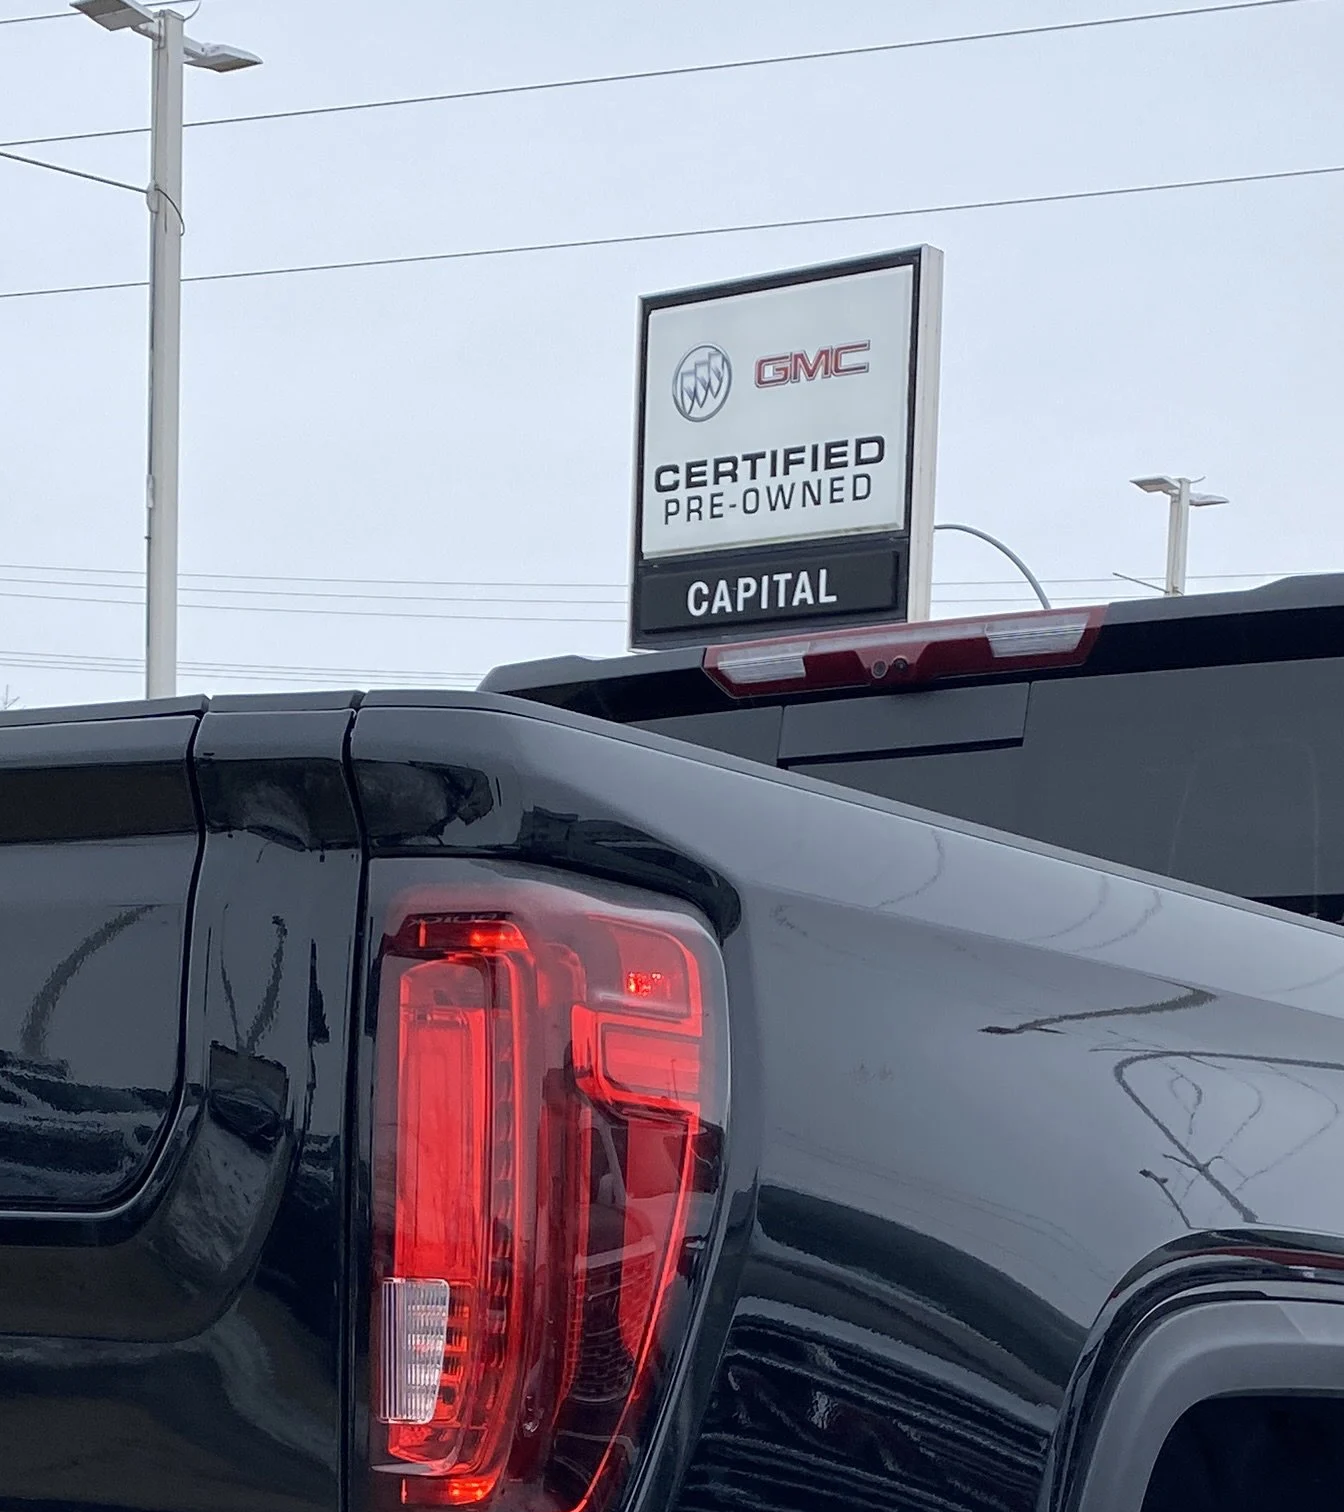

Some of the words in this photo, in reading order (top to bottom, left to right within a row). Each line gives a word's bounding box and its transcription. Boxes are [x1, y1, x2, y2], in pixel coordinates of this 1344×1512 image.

[755, 340, 870, 388] GMC
[654, 436, 885, 493] CERTIFIED
[664, 473, 872, 526] PRE-OWNED
[686, 568, 837, 617] CAPITAL
